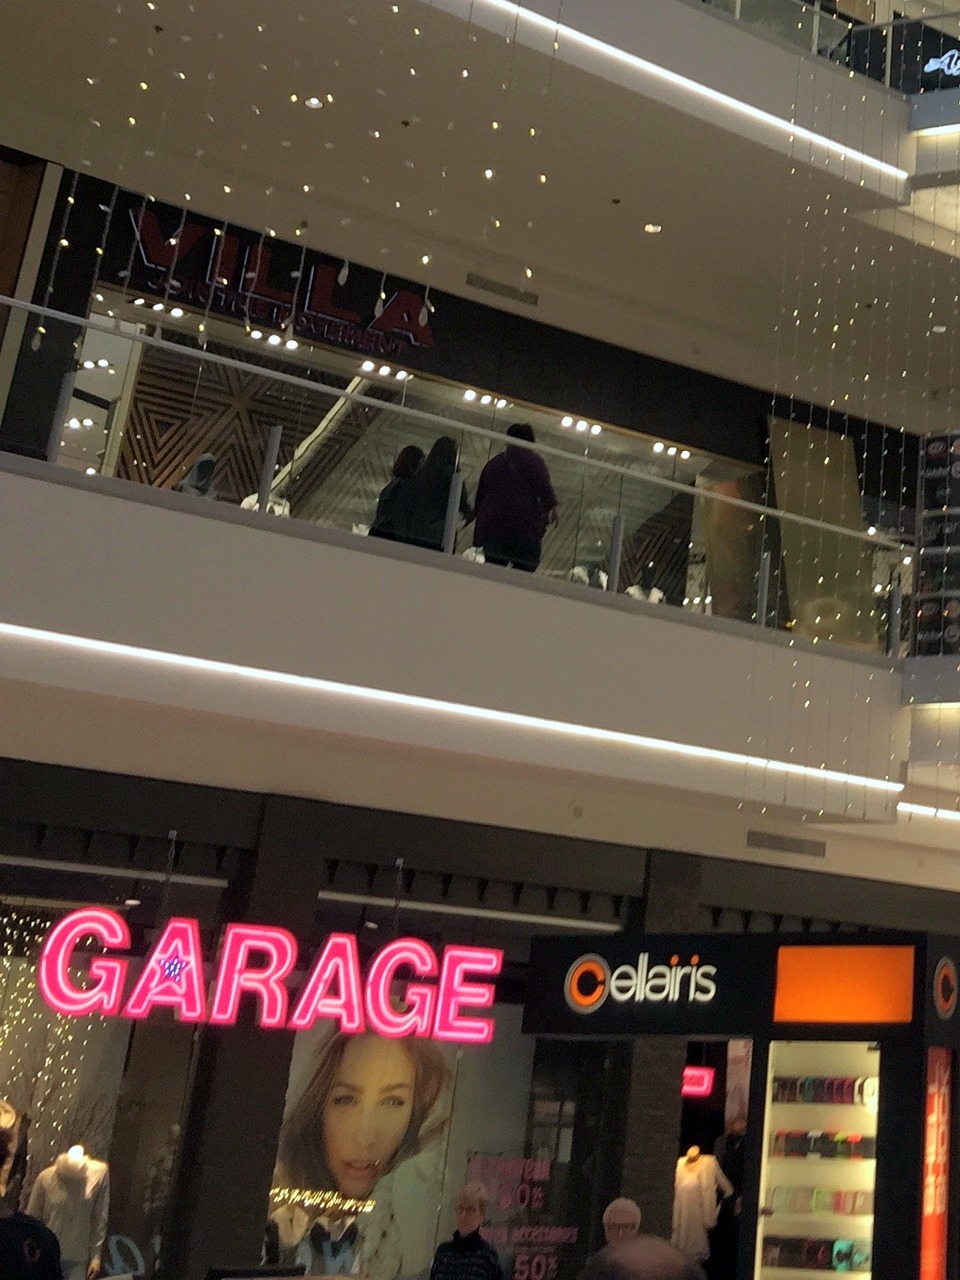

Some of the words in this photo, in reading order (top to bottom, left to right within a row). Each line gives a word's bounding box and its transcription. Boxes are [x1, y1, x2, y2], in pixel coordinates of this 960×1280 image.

[129, 208, 436, 348] VILLA
[39, 905, 504, 1044] GARAGE
[564, 952, 718, 1015] Cellairis
